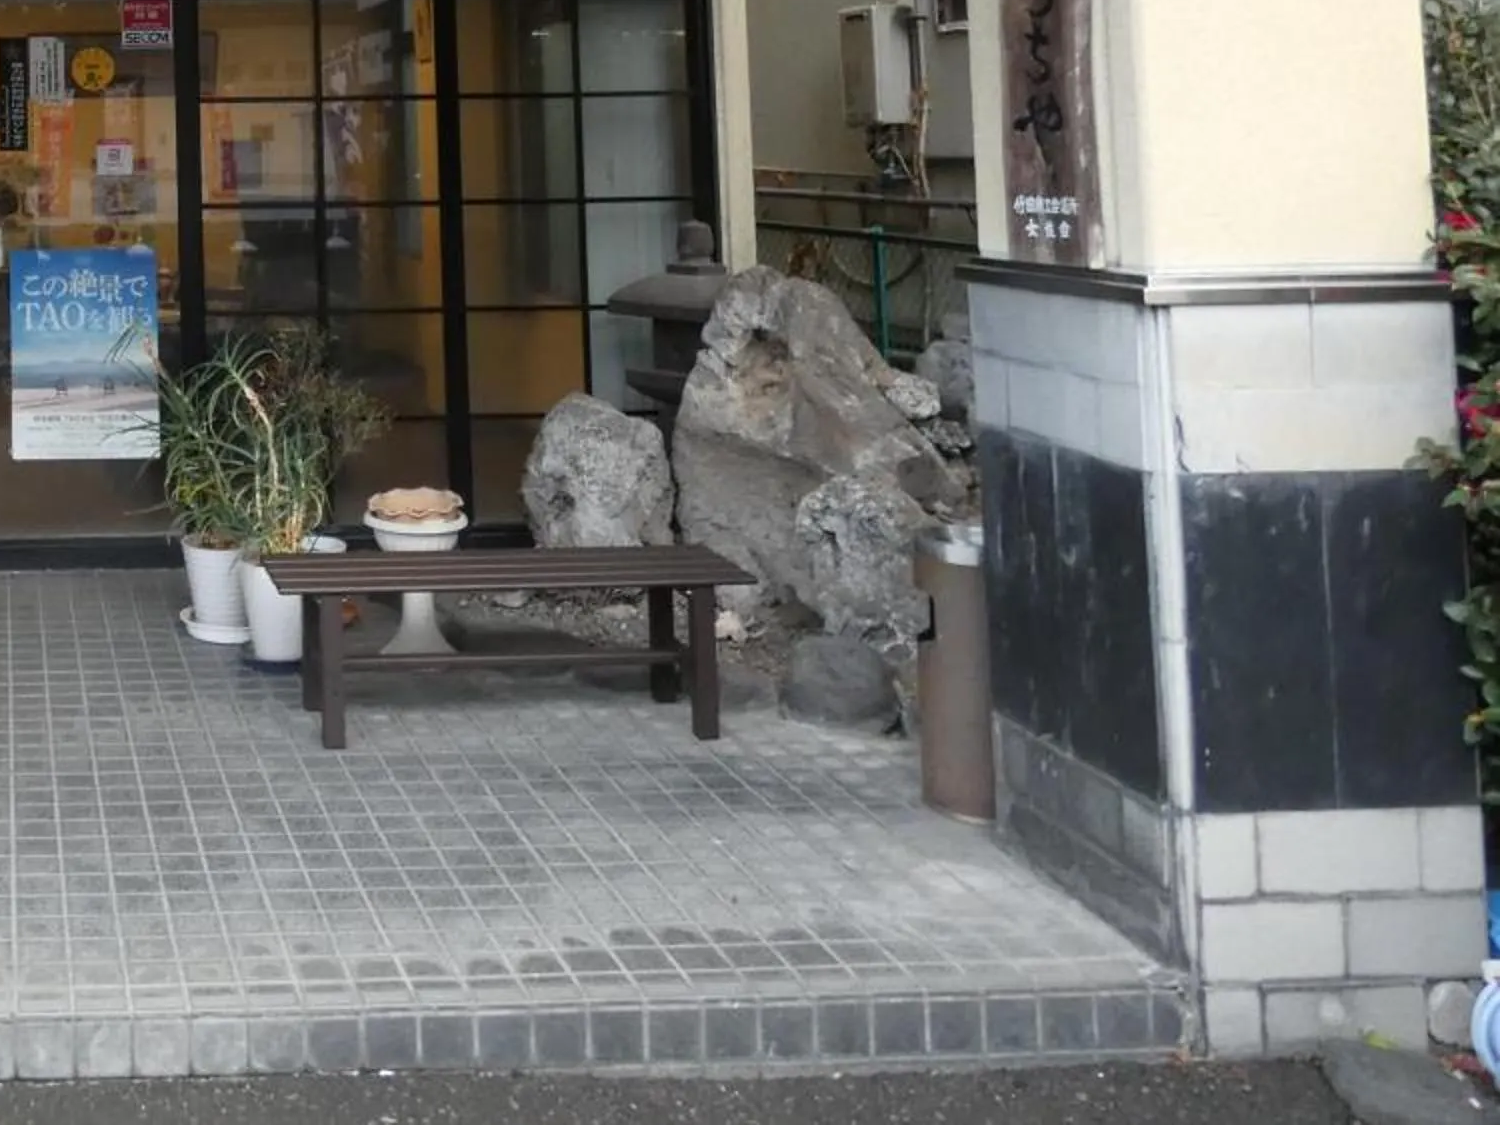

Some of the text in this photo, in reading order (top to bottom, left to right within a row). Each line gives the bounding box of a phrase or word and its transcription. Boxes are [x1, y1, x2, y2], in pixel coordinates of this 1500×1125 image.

[124, 32, 169, 44] SECOM
[22, 268, 149, 304] この絶景で
